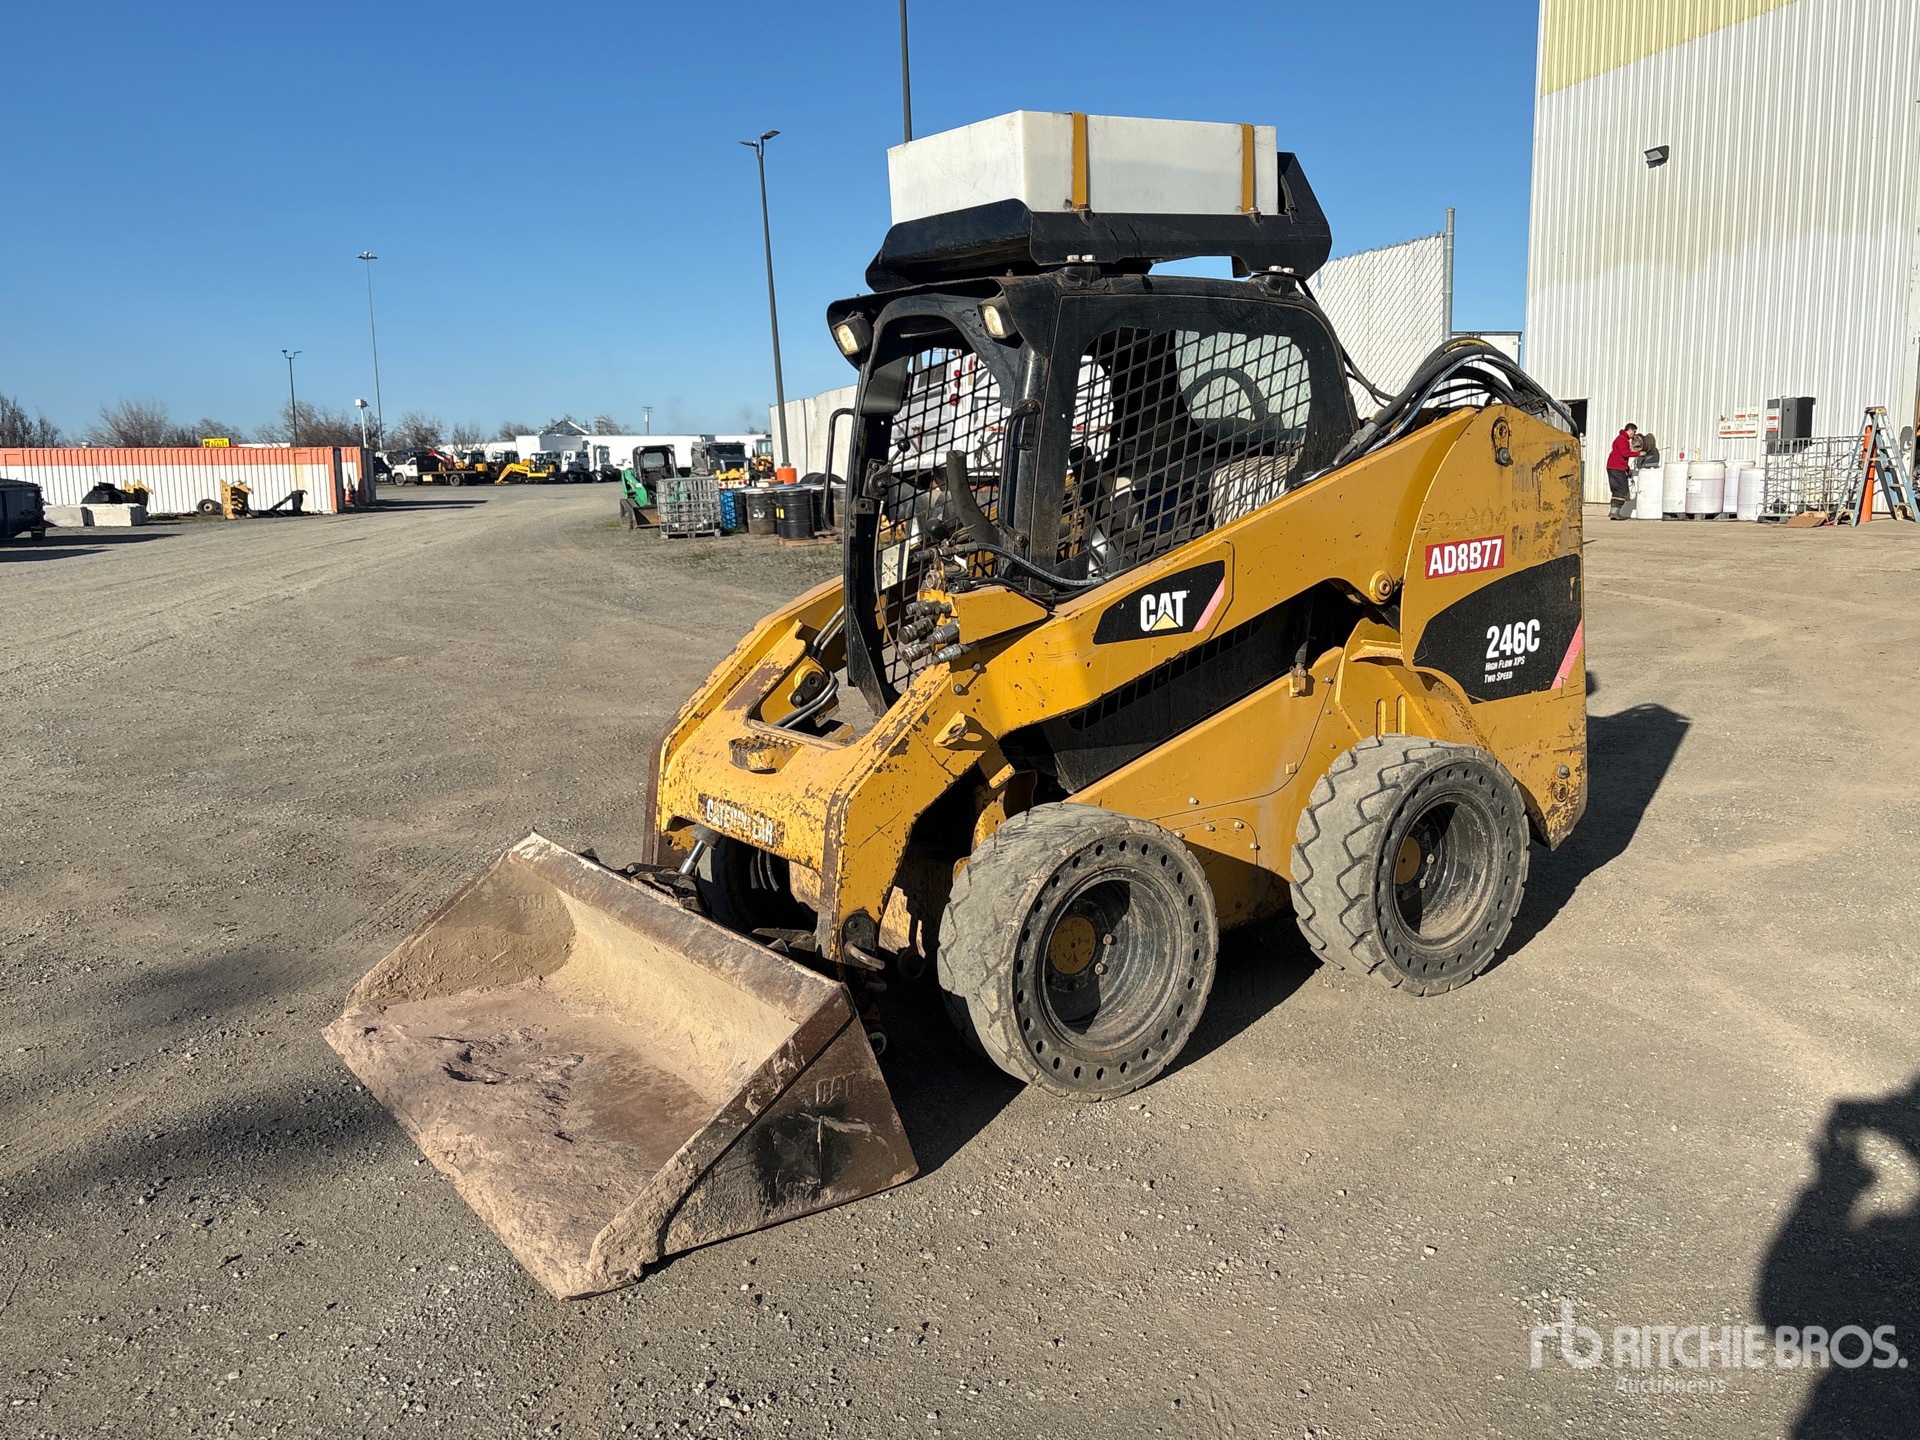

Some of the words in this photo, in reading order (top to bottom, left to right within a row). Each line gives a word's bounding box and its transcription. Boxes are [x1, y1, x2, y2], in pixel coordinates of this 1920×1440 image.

[1428, 539, 1503, 576] AD8B77
[1140, 590, 1188, 632] CAT
[1486, 618, 1541, 659] 246C
[1484, 674, 1496, 683] TWO
[1496, 670, 1513, 681] SPEED
[1498, 659, 1513, 669] FLOW
[1513, 655, 1526, 666] XPS
